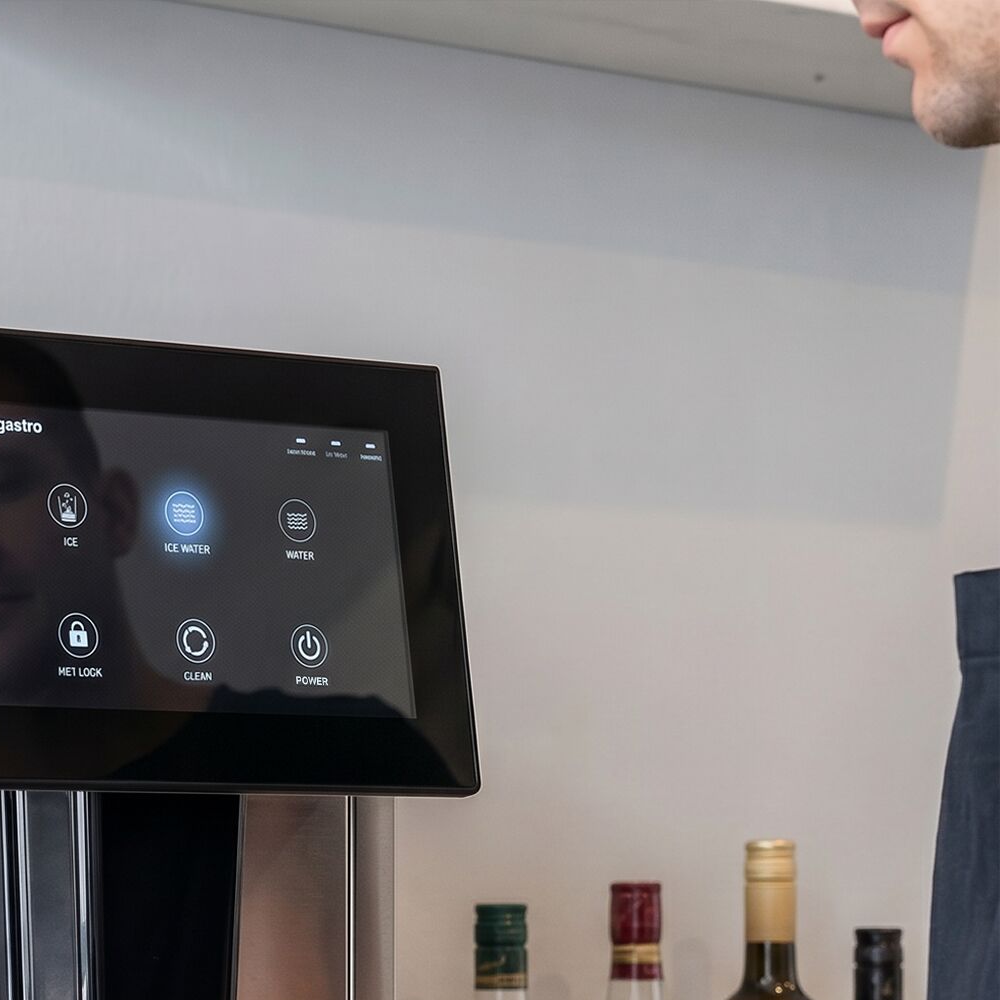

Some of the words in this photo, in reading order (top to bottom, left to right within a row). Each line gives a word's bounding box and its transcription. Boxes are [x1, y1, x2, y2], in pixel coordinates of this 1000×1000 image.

[63, 536, 79, 547] ICE
[164, 542, 179, 553] ICE
[180, 543, 211, 555] WATER
[285, 549, 315, 561] WATER
[78, 667, 103, 678] LOCK
[183, 671, 213, 682] CLEAN
[295, 675, 329, 686] POWER
